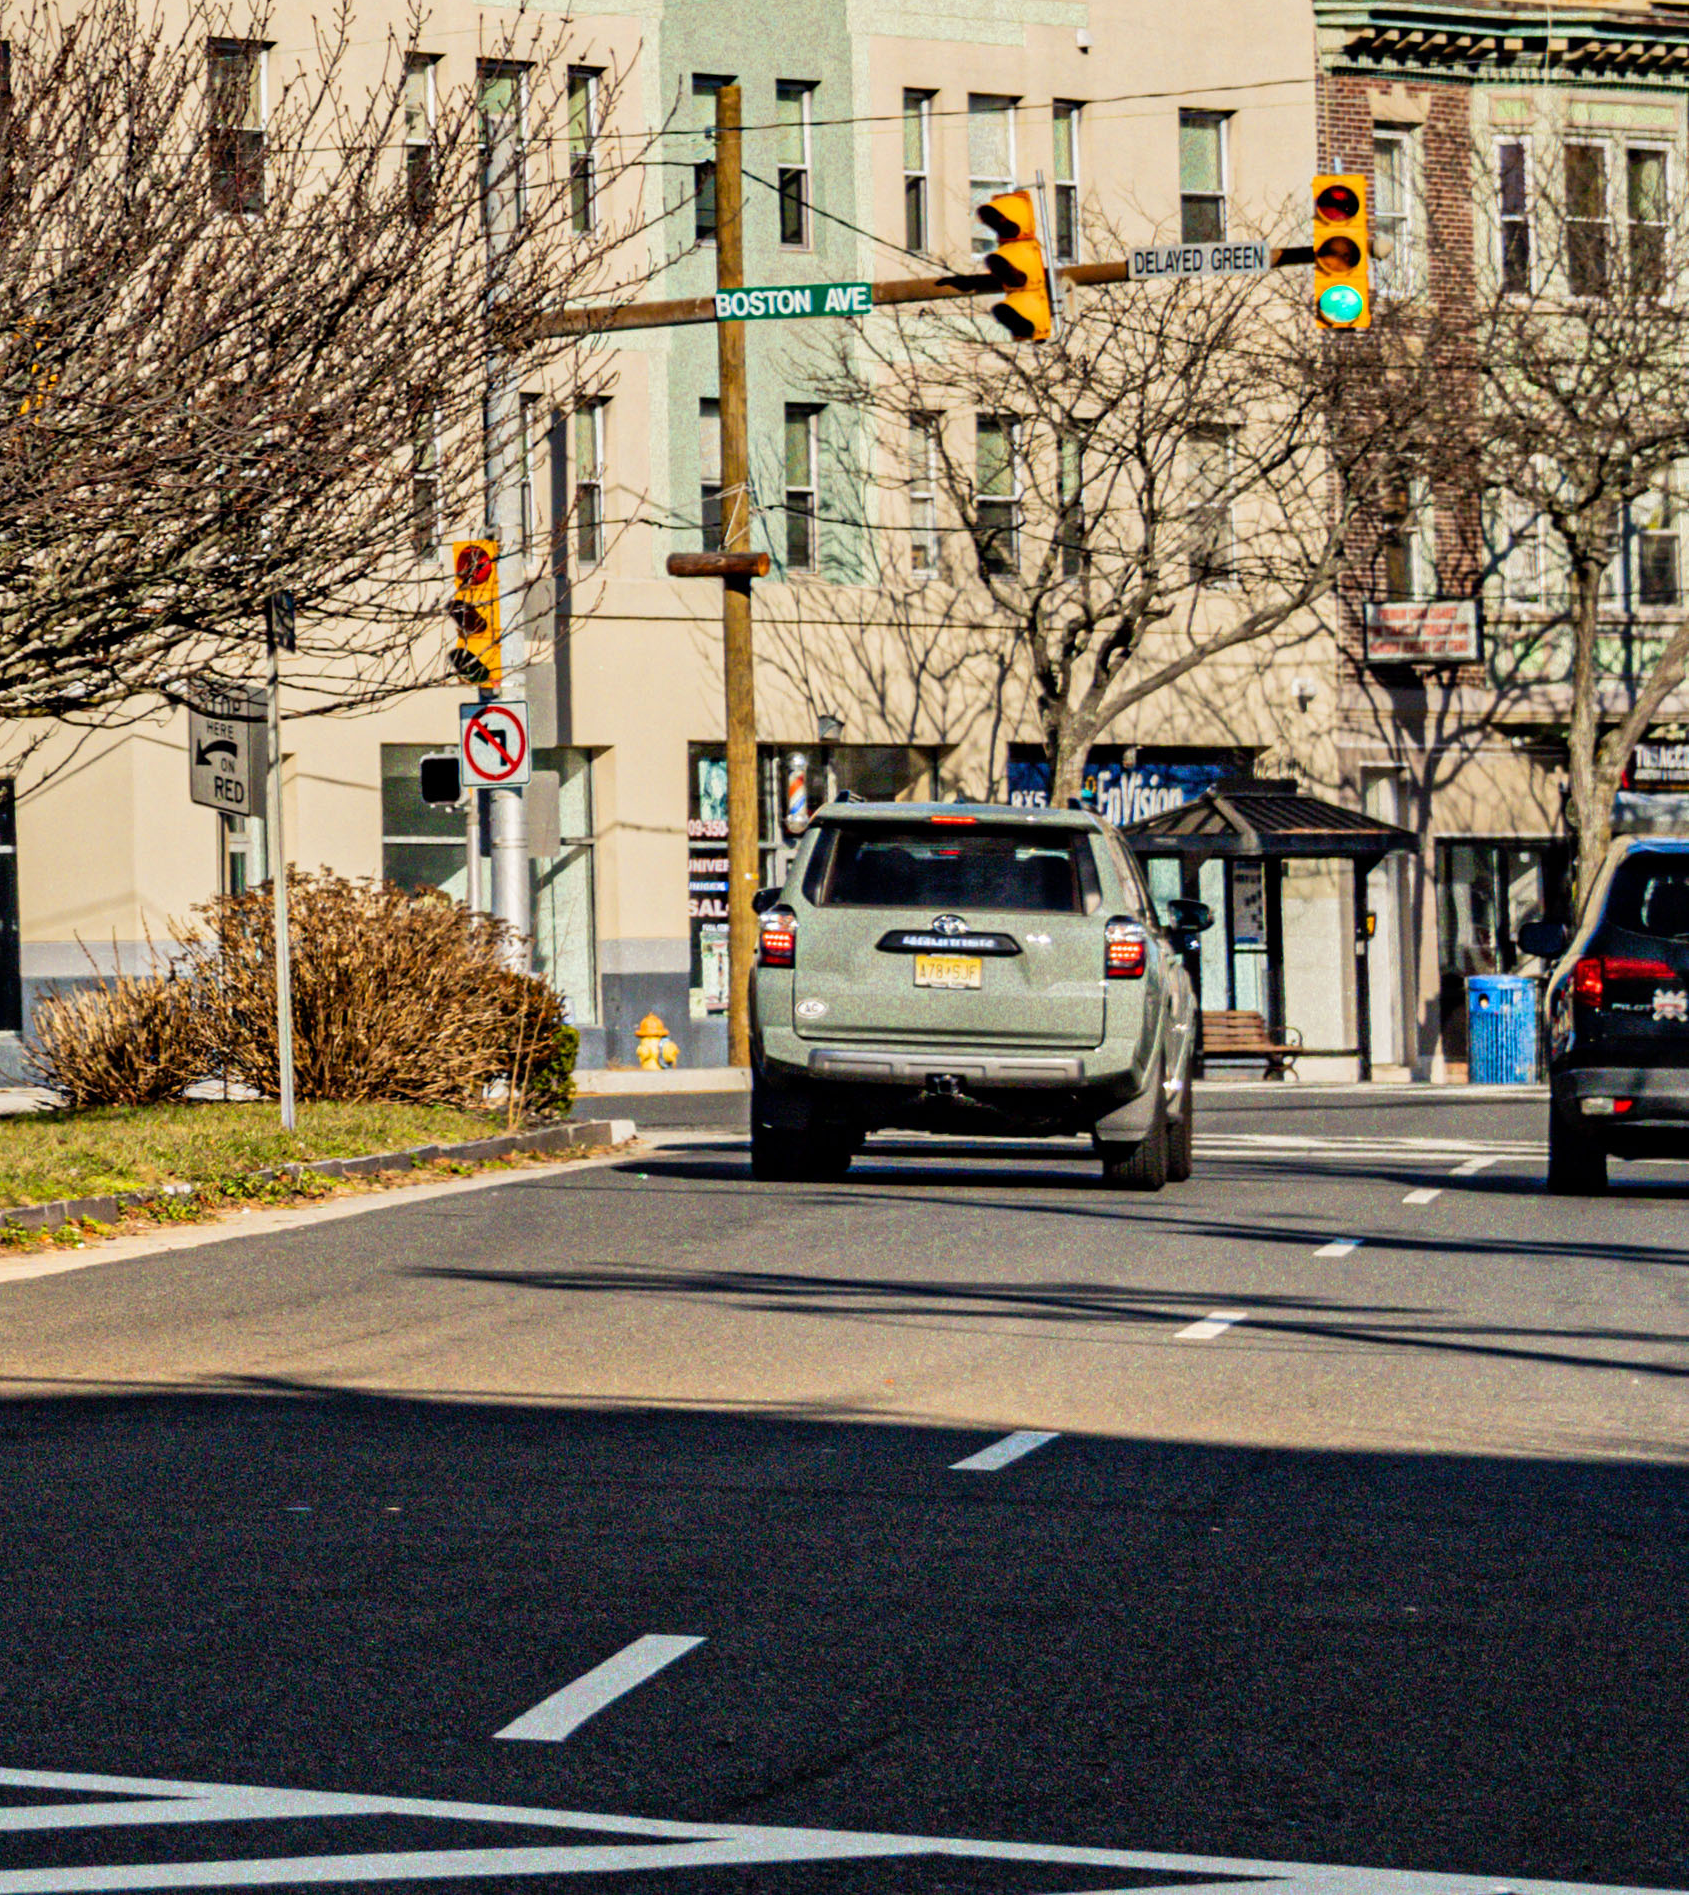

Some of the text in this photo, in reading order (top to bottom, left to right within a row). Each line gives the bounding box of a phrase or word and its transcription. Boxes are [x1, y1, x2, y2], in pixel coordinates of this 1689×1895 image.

[1135, 246, 1264, 274] DELAYED GREEN
[715, 289, 812, 317] BOSTON
[207, 720, 234, 739] HERE
[221, 758, 235, 773] ON
[214, 776, 245, 804] RED
